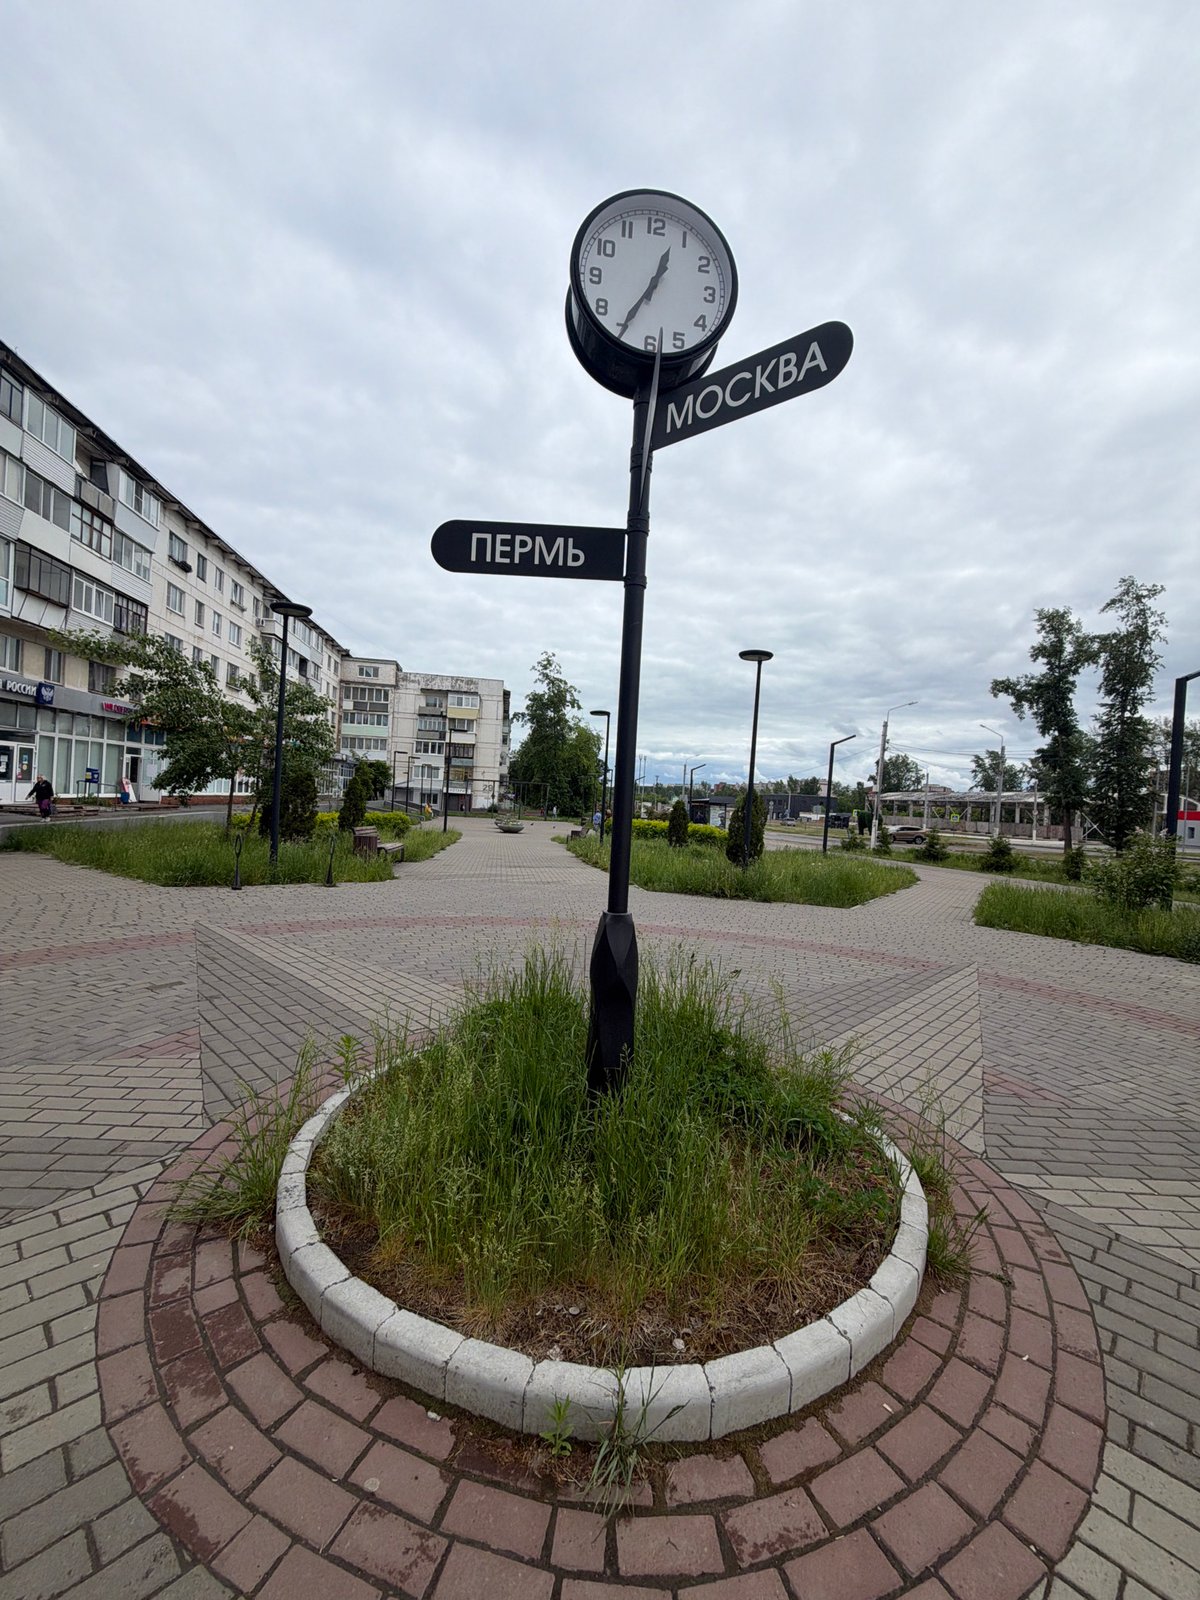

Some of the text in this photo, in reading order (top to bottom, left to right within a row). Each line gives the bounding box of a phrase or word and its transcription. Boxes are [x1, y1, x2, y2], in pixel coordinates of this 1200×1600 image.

[621, 220, 634, 239] 11
[647, 217, 666, 237] 12
[597, 238, 615, 258] 10
[697, 255, 711, 274] 2
[589, 266, 603, 285] 9
[703, 285, 716, 304] 3
[595, 298, 609, 316] 8
[693, 314, 708, 332] 4
[644, 335, 657, 352] 6
[672, 331, 686, 350] 5
[665, 341, 828, 433] МОСКВА
[470, 532, 585, 567] ПЕРМЬ
[6, 680, 37, 696] РОССИИ
